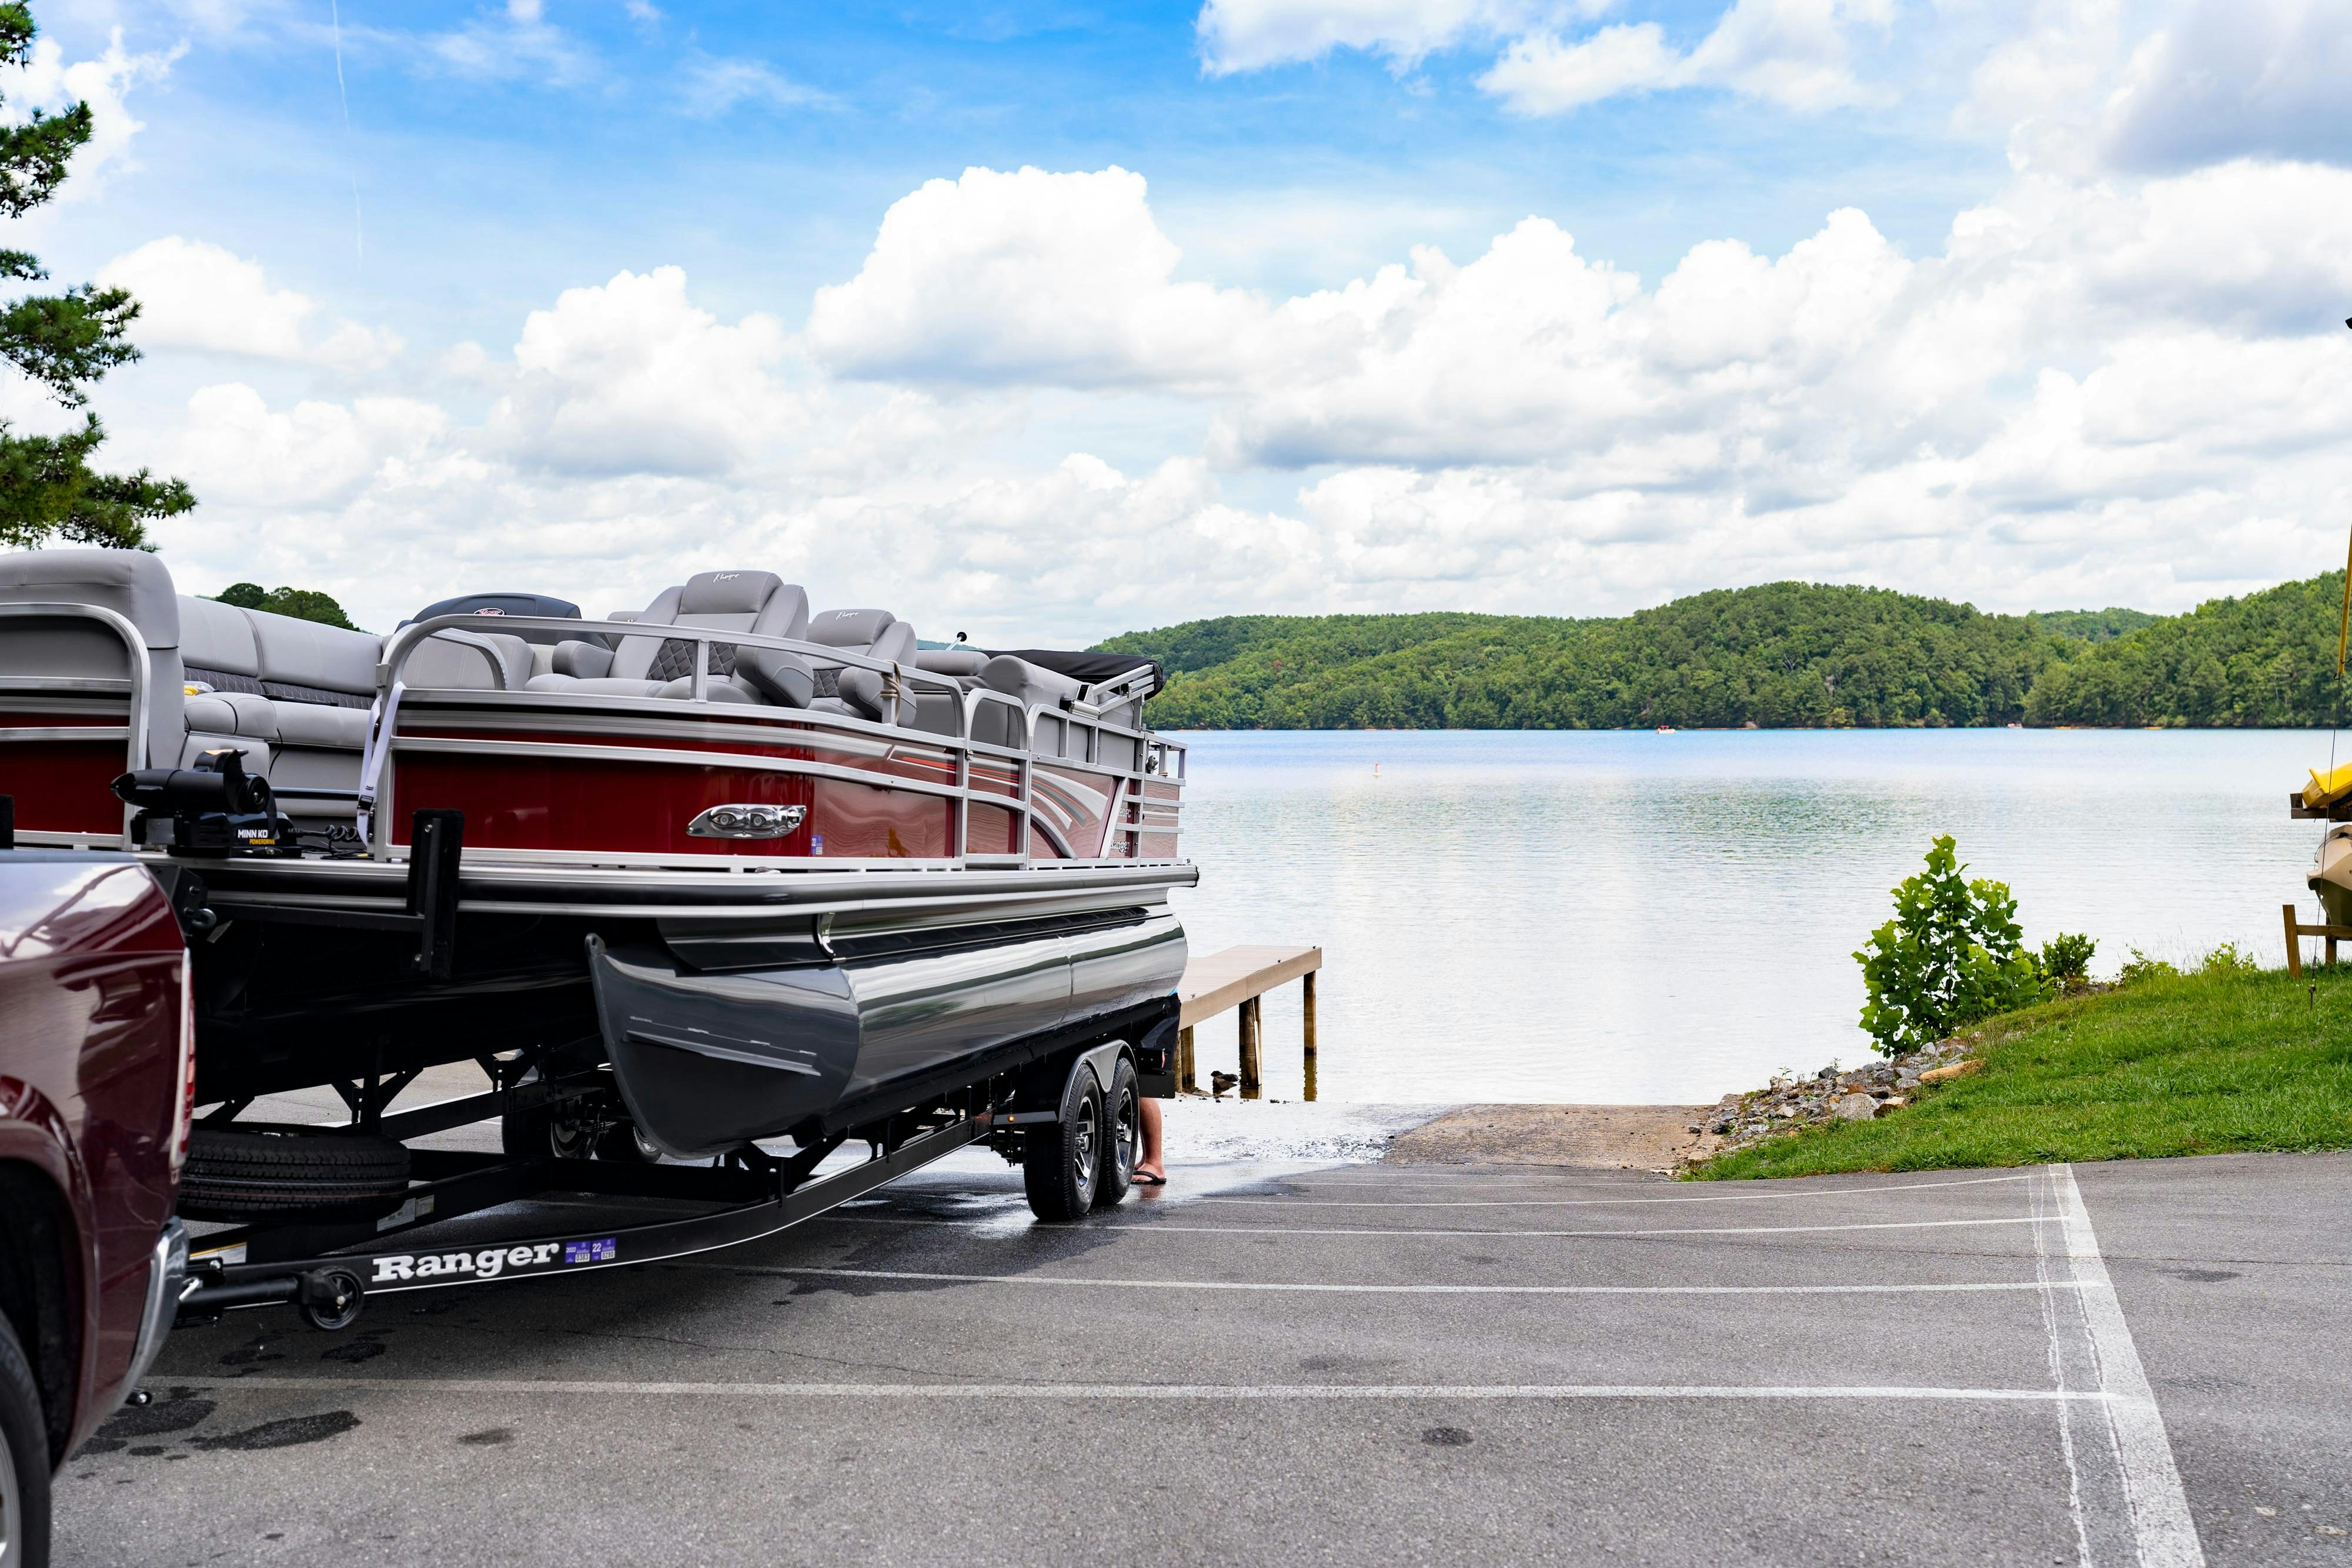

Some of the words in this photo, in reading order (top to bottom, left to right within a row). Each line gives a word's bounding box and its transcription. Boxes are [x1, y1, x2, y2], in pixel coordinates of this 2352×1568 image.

[238, 830, 257, 838] MINN
[592, 1243, 601, 1253] 22
[372, 1243, 559, 1282] Ranger
